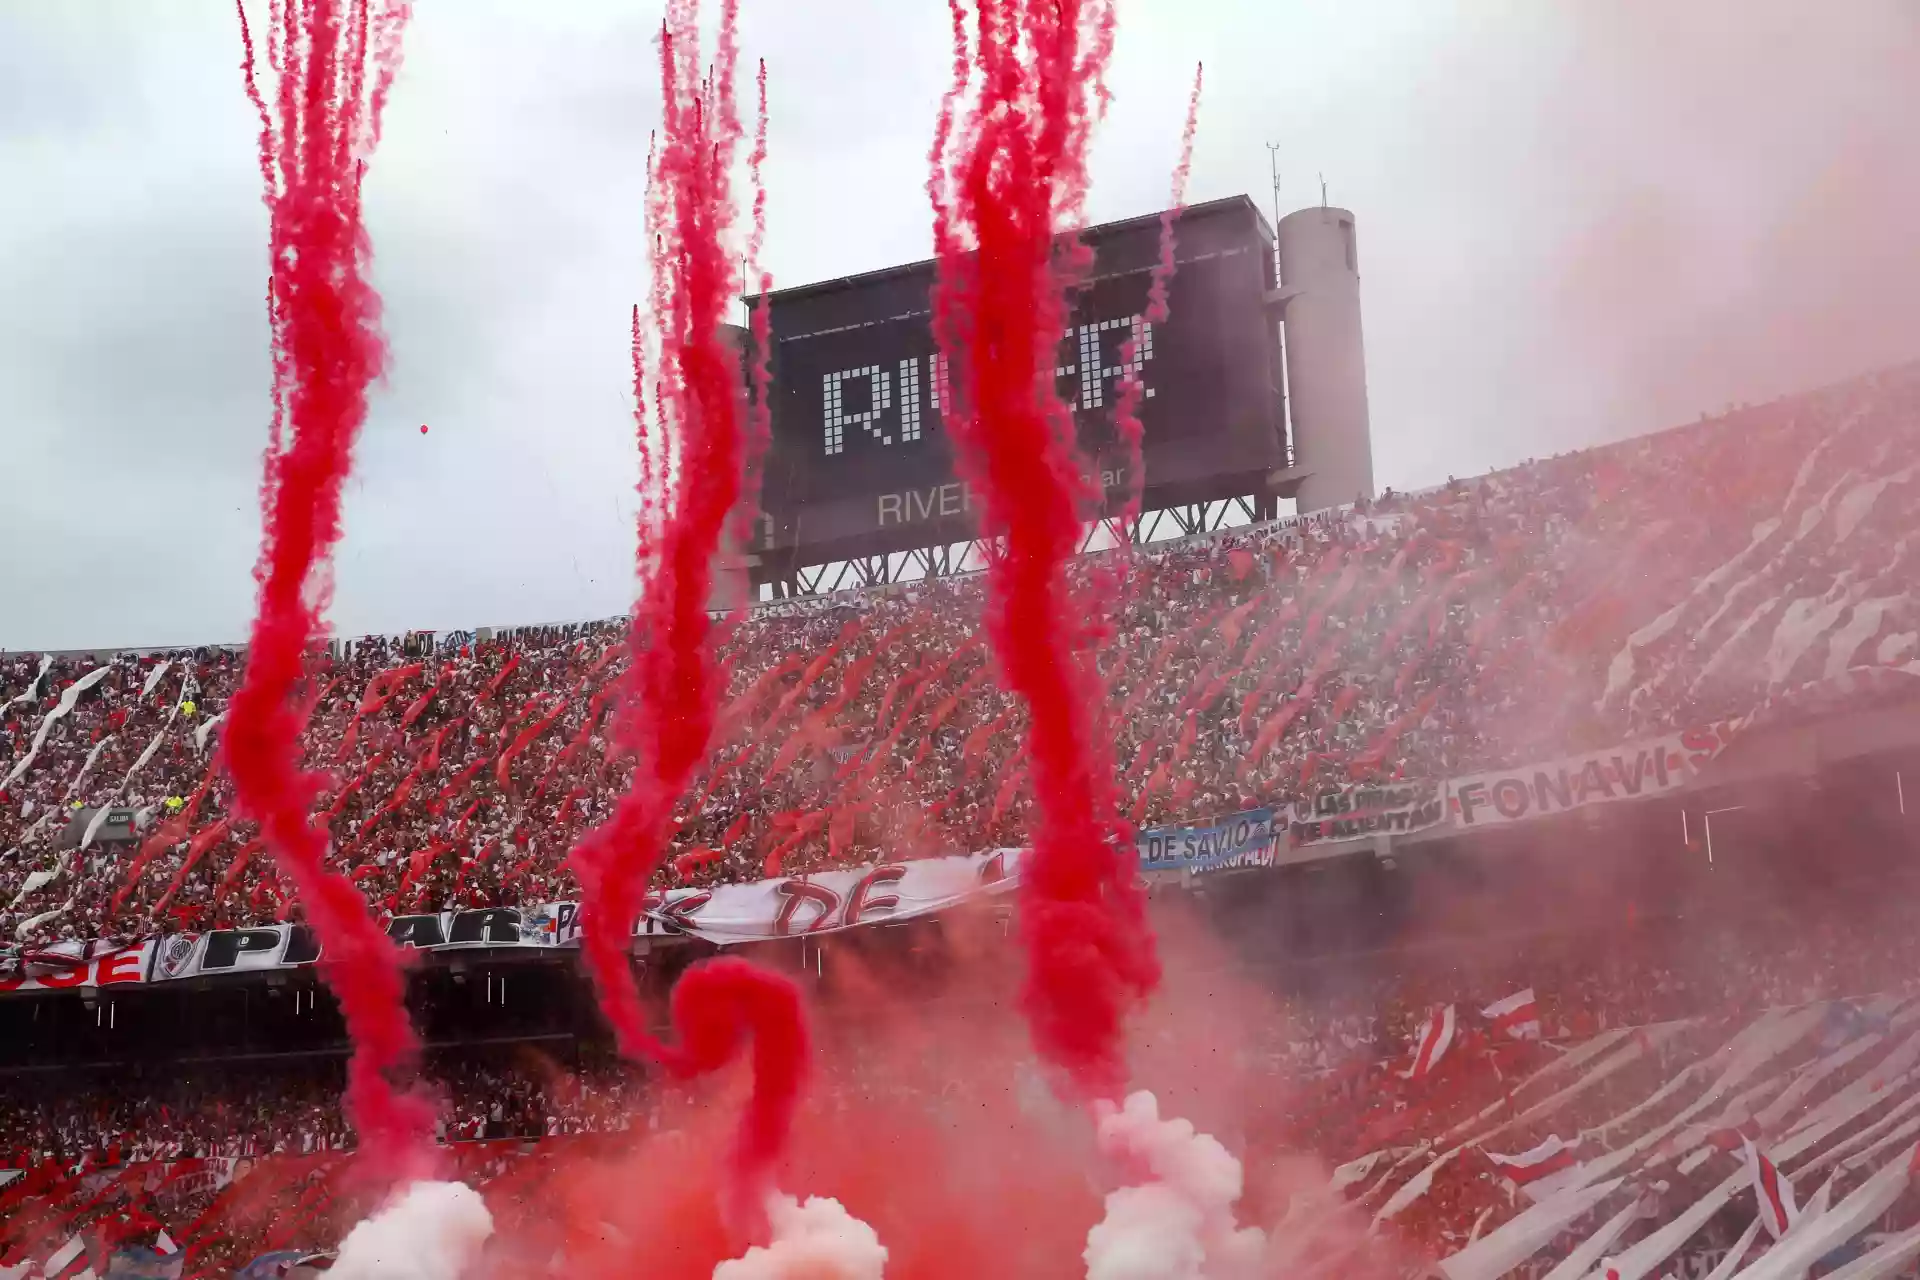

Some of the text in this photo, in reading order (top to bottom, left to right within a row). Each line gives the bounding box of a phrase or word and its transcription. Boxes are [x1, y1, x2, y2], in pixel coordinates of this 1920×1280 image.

[110, 815, 129, 823] SALIDA
[1150, 819, 1250, 863] DE SAVIO
